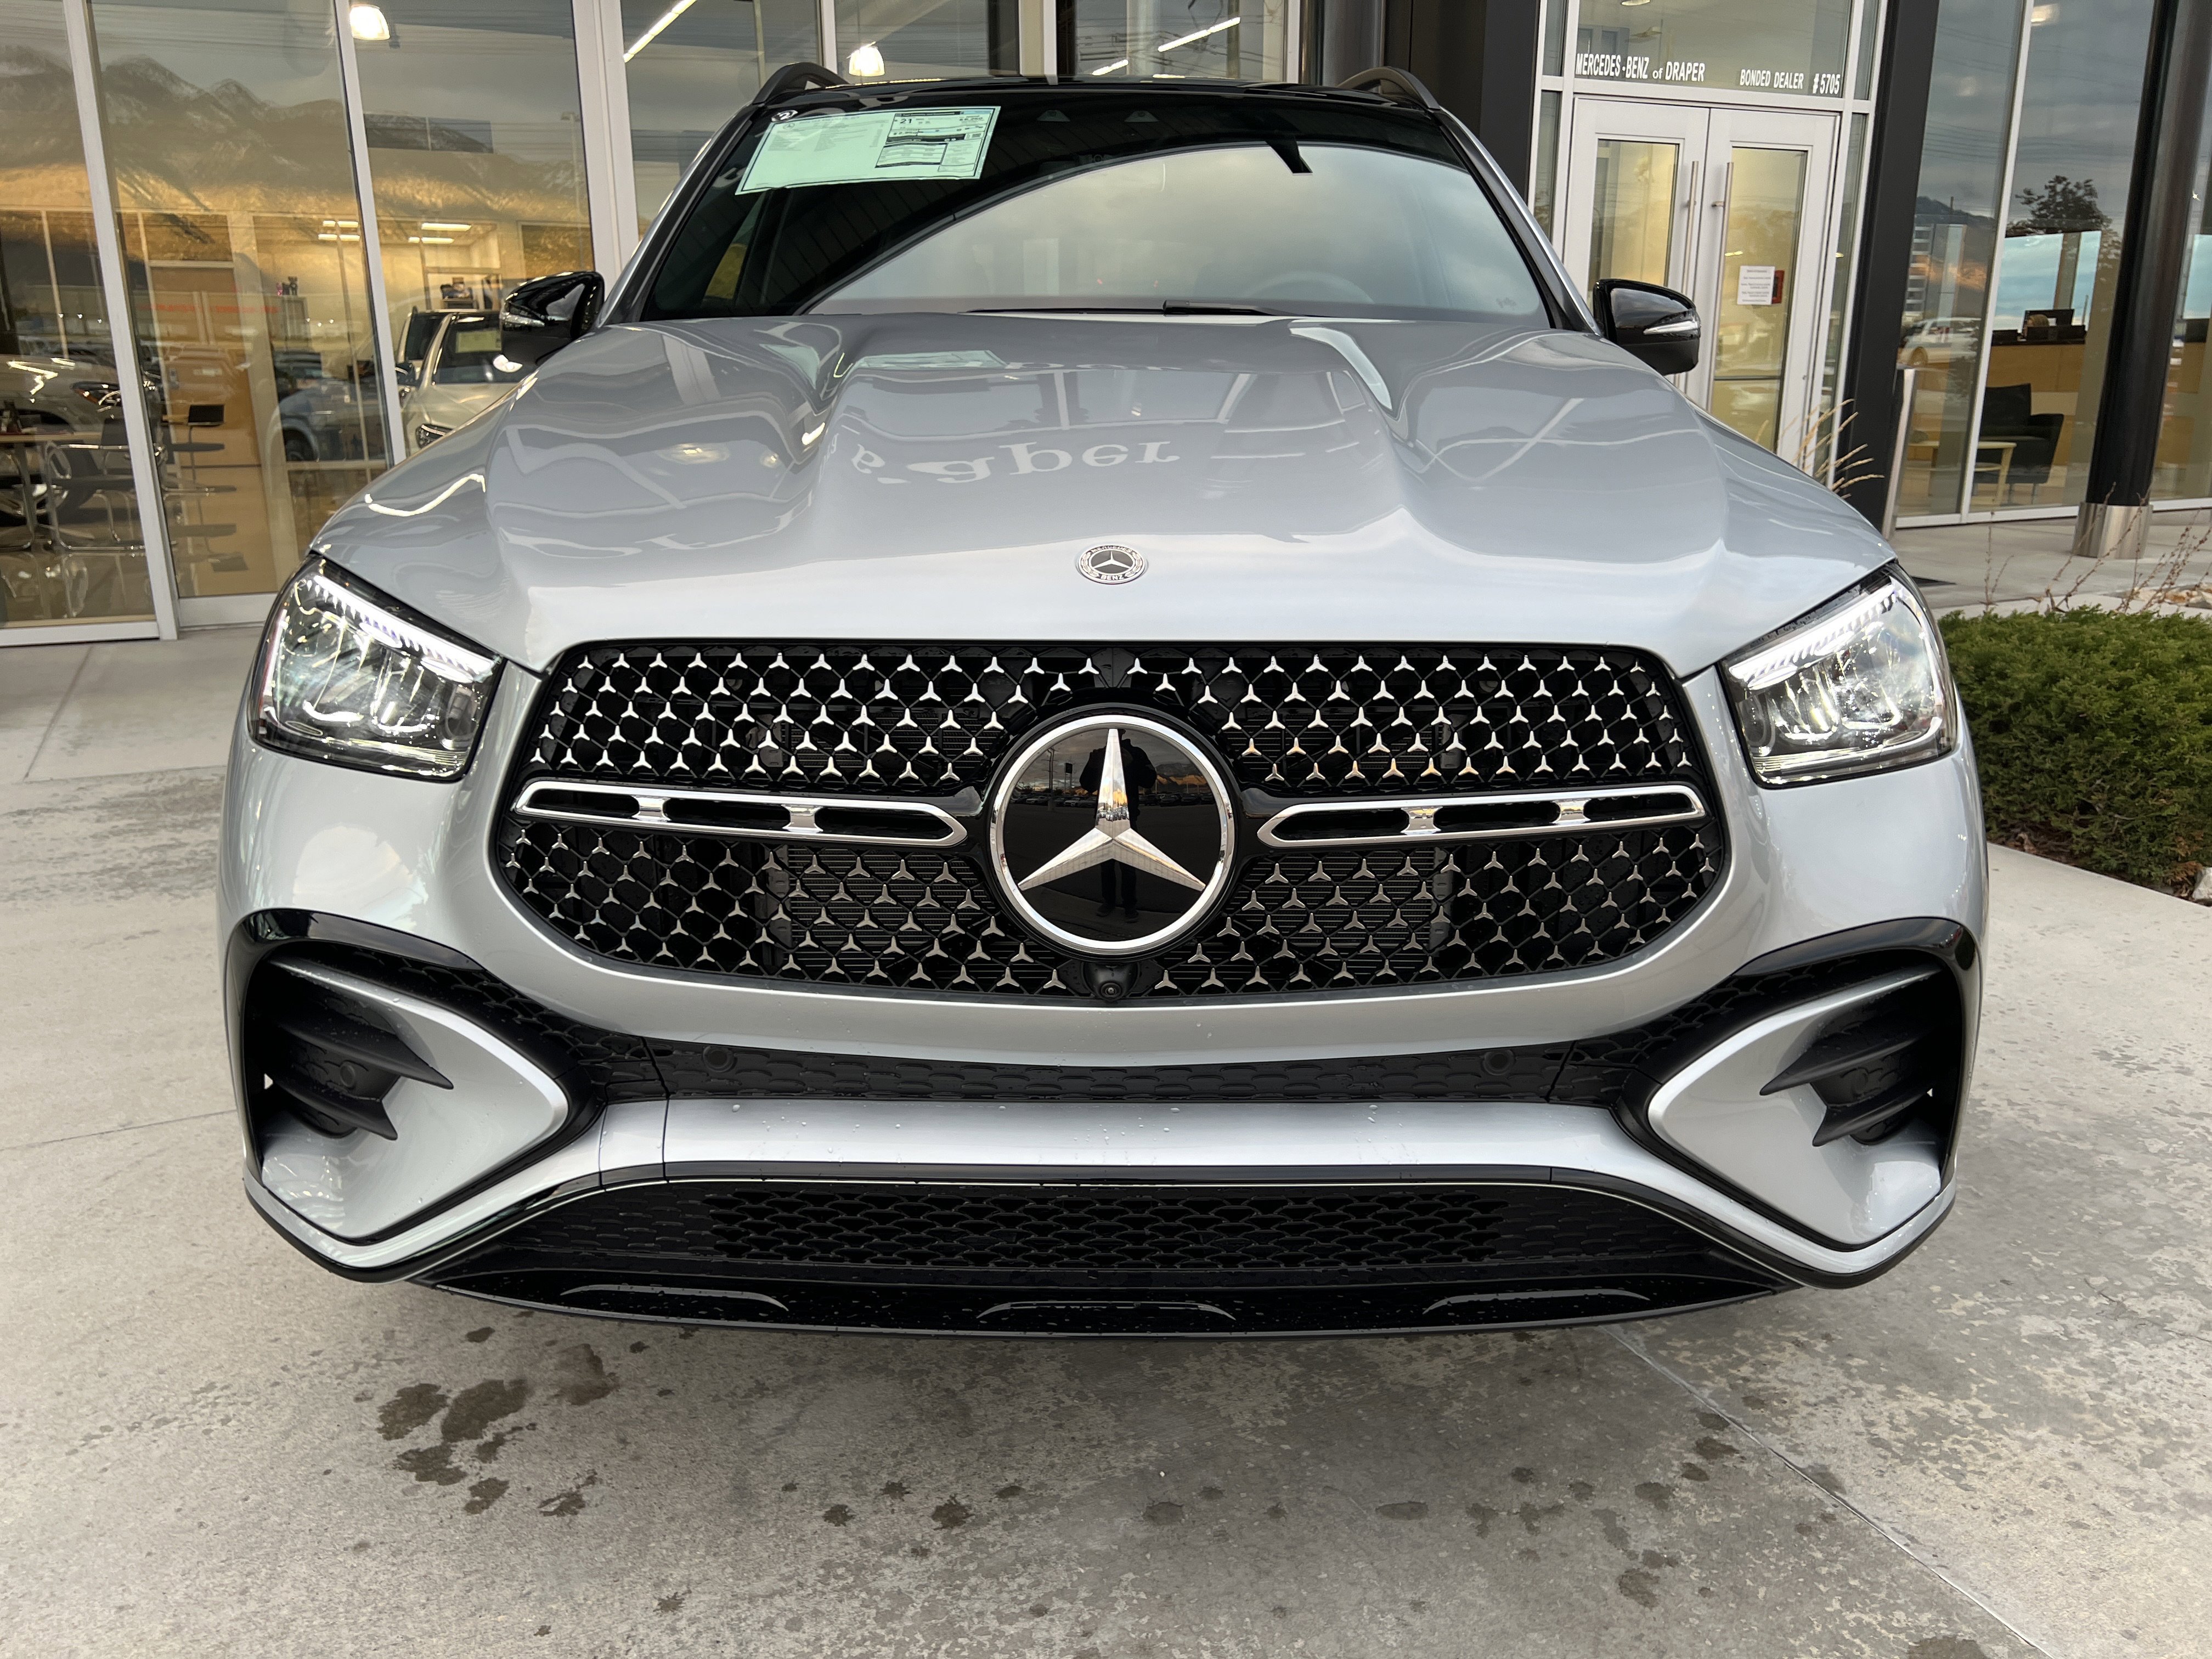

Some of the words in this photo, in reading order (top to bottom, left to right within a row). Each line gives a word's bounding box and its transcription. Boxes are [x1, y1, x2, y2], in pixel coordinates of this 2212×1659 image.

[1652, 67, 1663, 80] of
[1665, 61, 1706, 82] DRAPER
[1740, 69, 1771, 87] BONDED
[1773, 71, 1804, 89] DEALER
